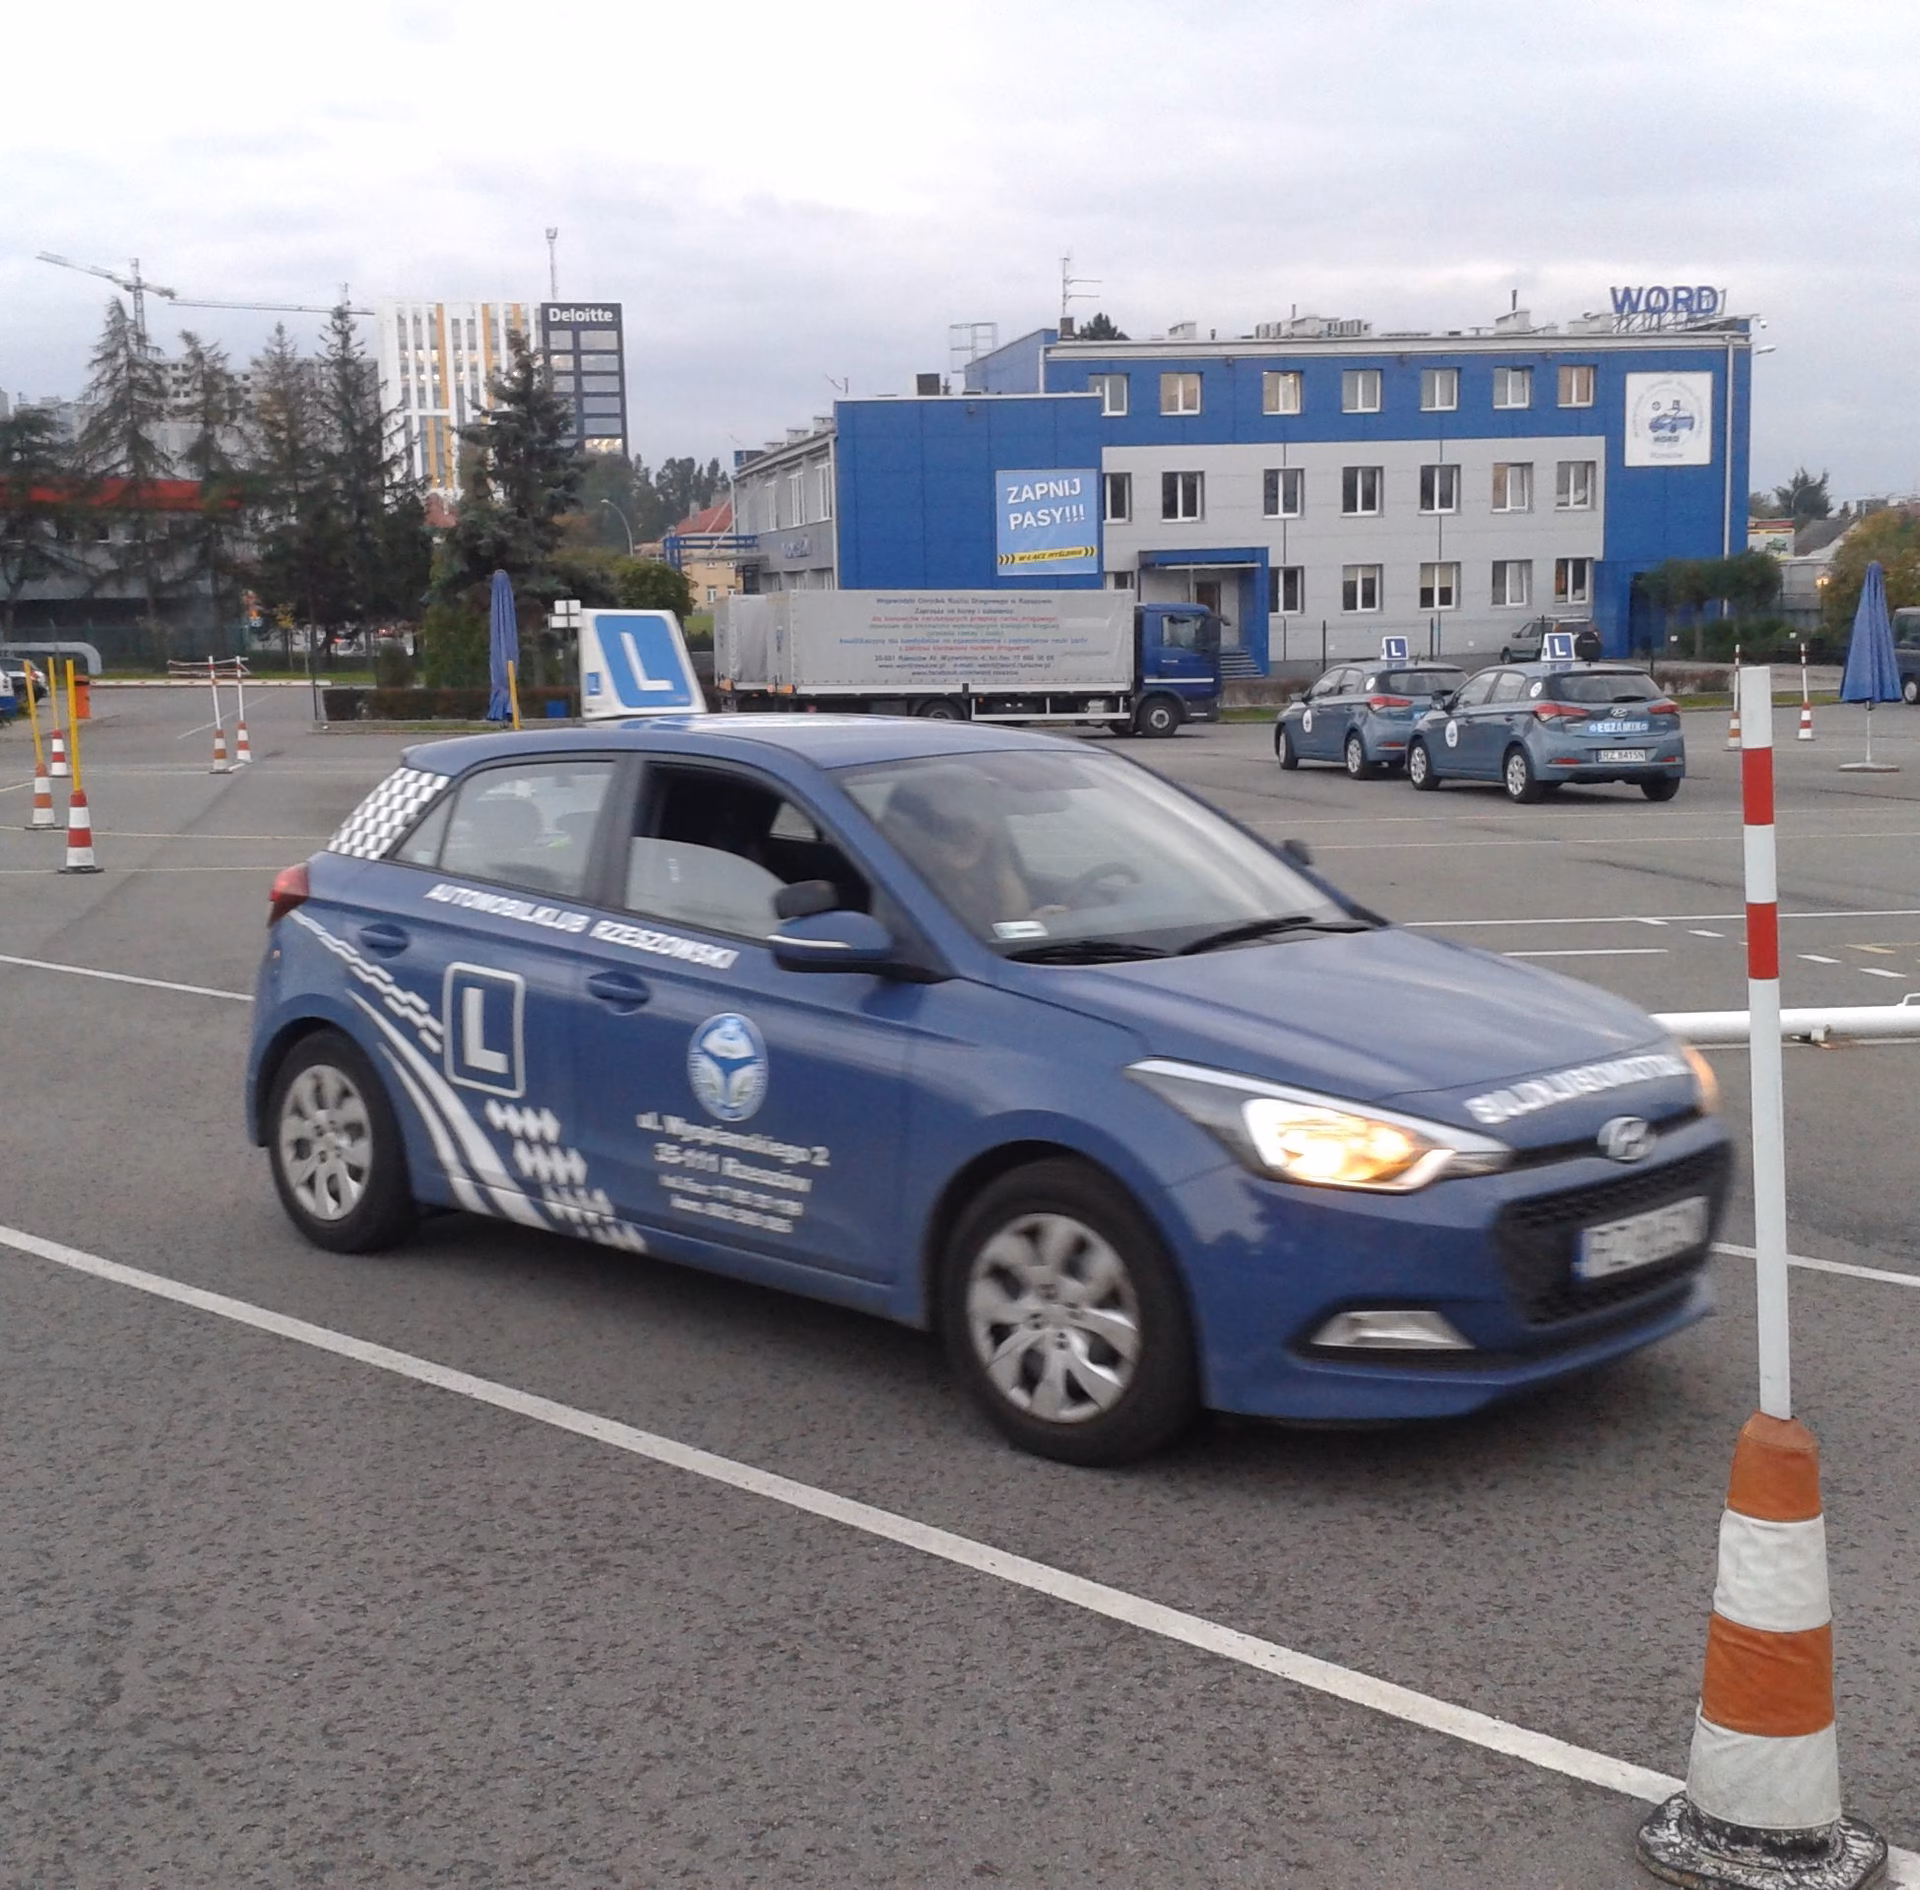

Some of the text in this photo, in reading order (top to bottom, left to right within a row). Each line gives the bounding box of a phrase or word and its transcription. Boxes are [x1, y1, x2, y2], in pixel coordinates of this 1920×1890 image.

[548, 307, 613, 322] Deloitte
[1610, 286, 1719, 316] WORD
[1006, 477, 1081, 505] ZAPNIJ
[1008, 503, 1086, 531] PASY!!!
[619, 631, 675, 691] L
[1390, 640, 1402, 657] L
[1553, 638, 1567, 656] L
[463, 987, 509, 1074] L
